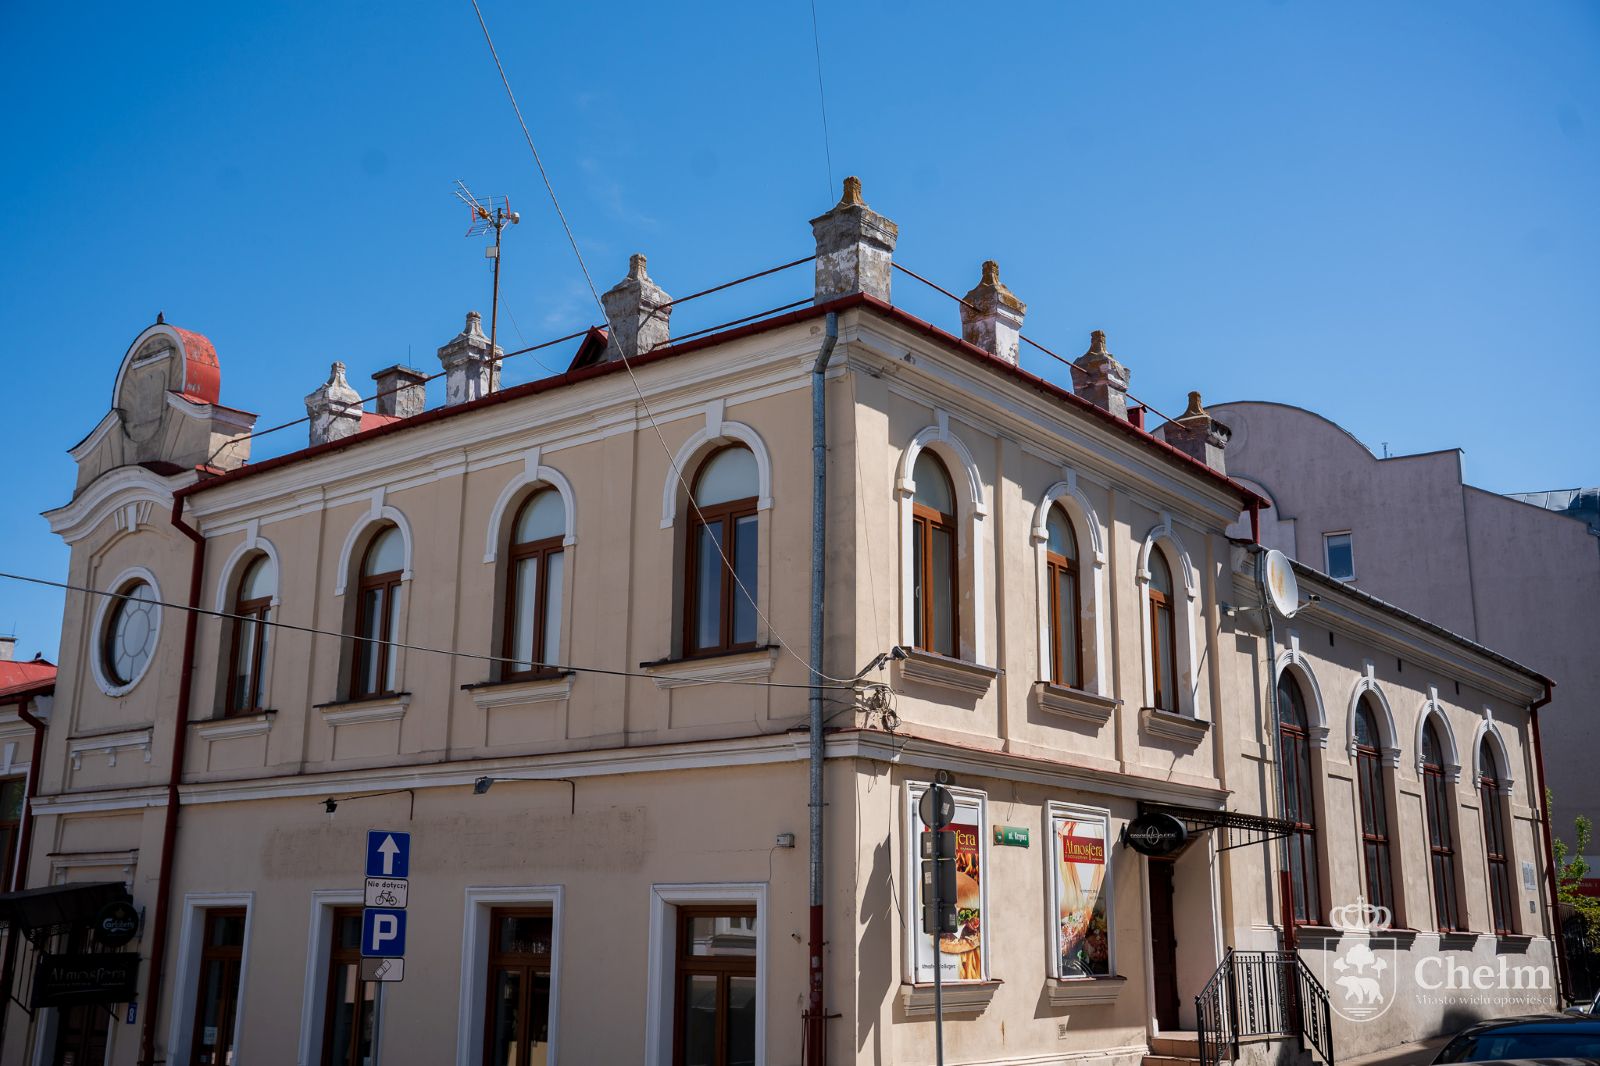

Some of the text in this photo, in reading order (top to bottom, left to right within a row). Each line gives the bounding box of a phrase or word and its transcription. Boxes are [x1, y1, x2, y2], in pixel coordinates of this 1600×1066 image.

[1065, 839, 1103, 861] Atmosfera
[368, 880, 406, 890] Nie dotyczy
[102, 917, 135, 930] Carlsberg
[372, 914, 398, 950] P
[49, 967, 126, 983] Atmosfera
[129, 1007, 135, 1022] 8
